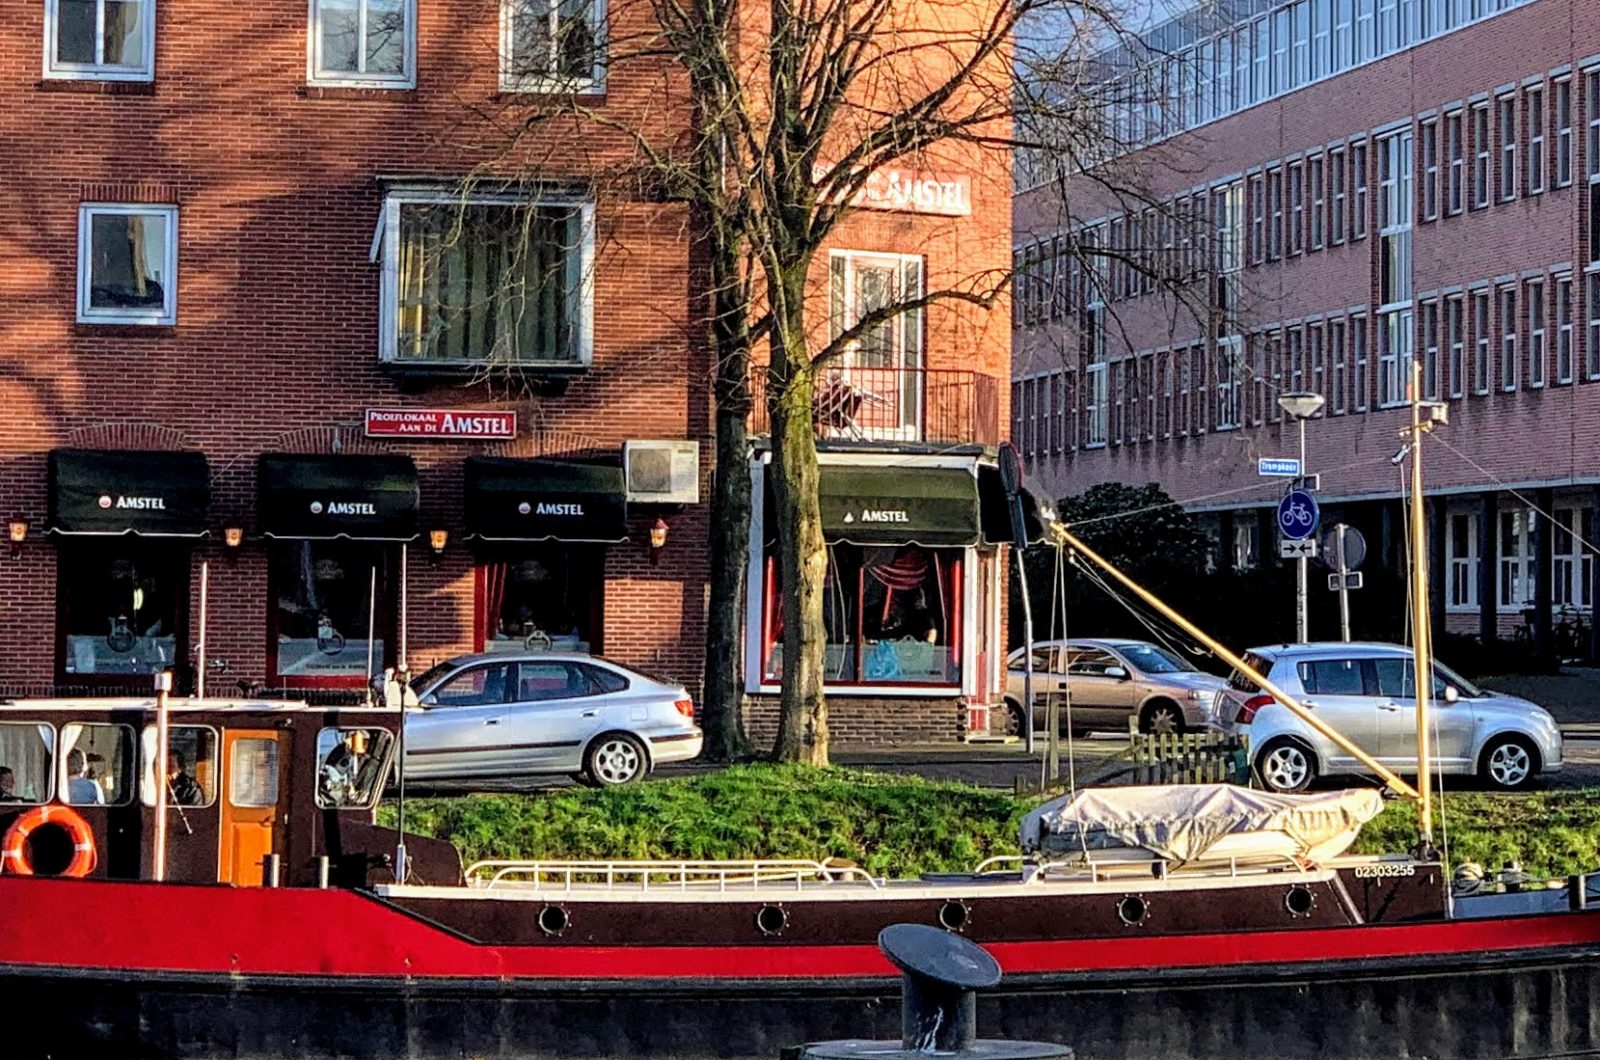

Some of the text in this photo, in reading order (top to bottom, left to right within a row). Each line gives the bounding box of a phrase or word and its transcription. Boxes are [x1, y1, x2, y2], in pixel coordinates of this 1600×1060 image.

[887, 171, 966, 209] AMSTEL
[399, 423, 437, 433] AAN DE
[441, 413, 511, 434] AMSTEL
[116, 495, 165, 510] AMSTEL
[327, 501, 376, 514] AMSTEL
[536, 502, 584, 515] AMSTEL
[861, 509, 909, 522] AMSTEL
[1355, 865, 1415, 878] 02303255
